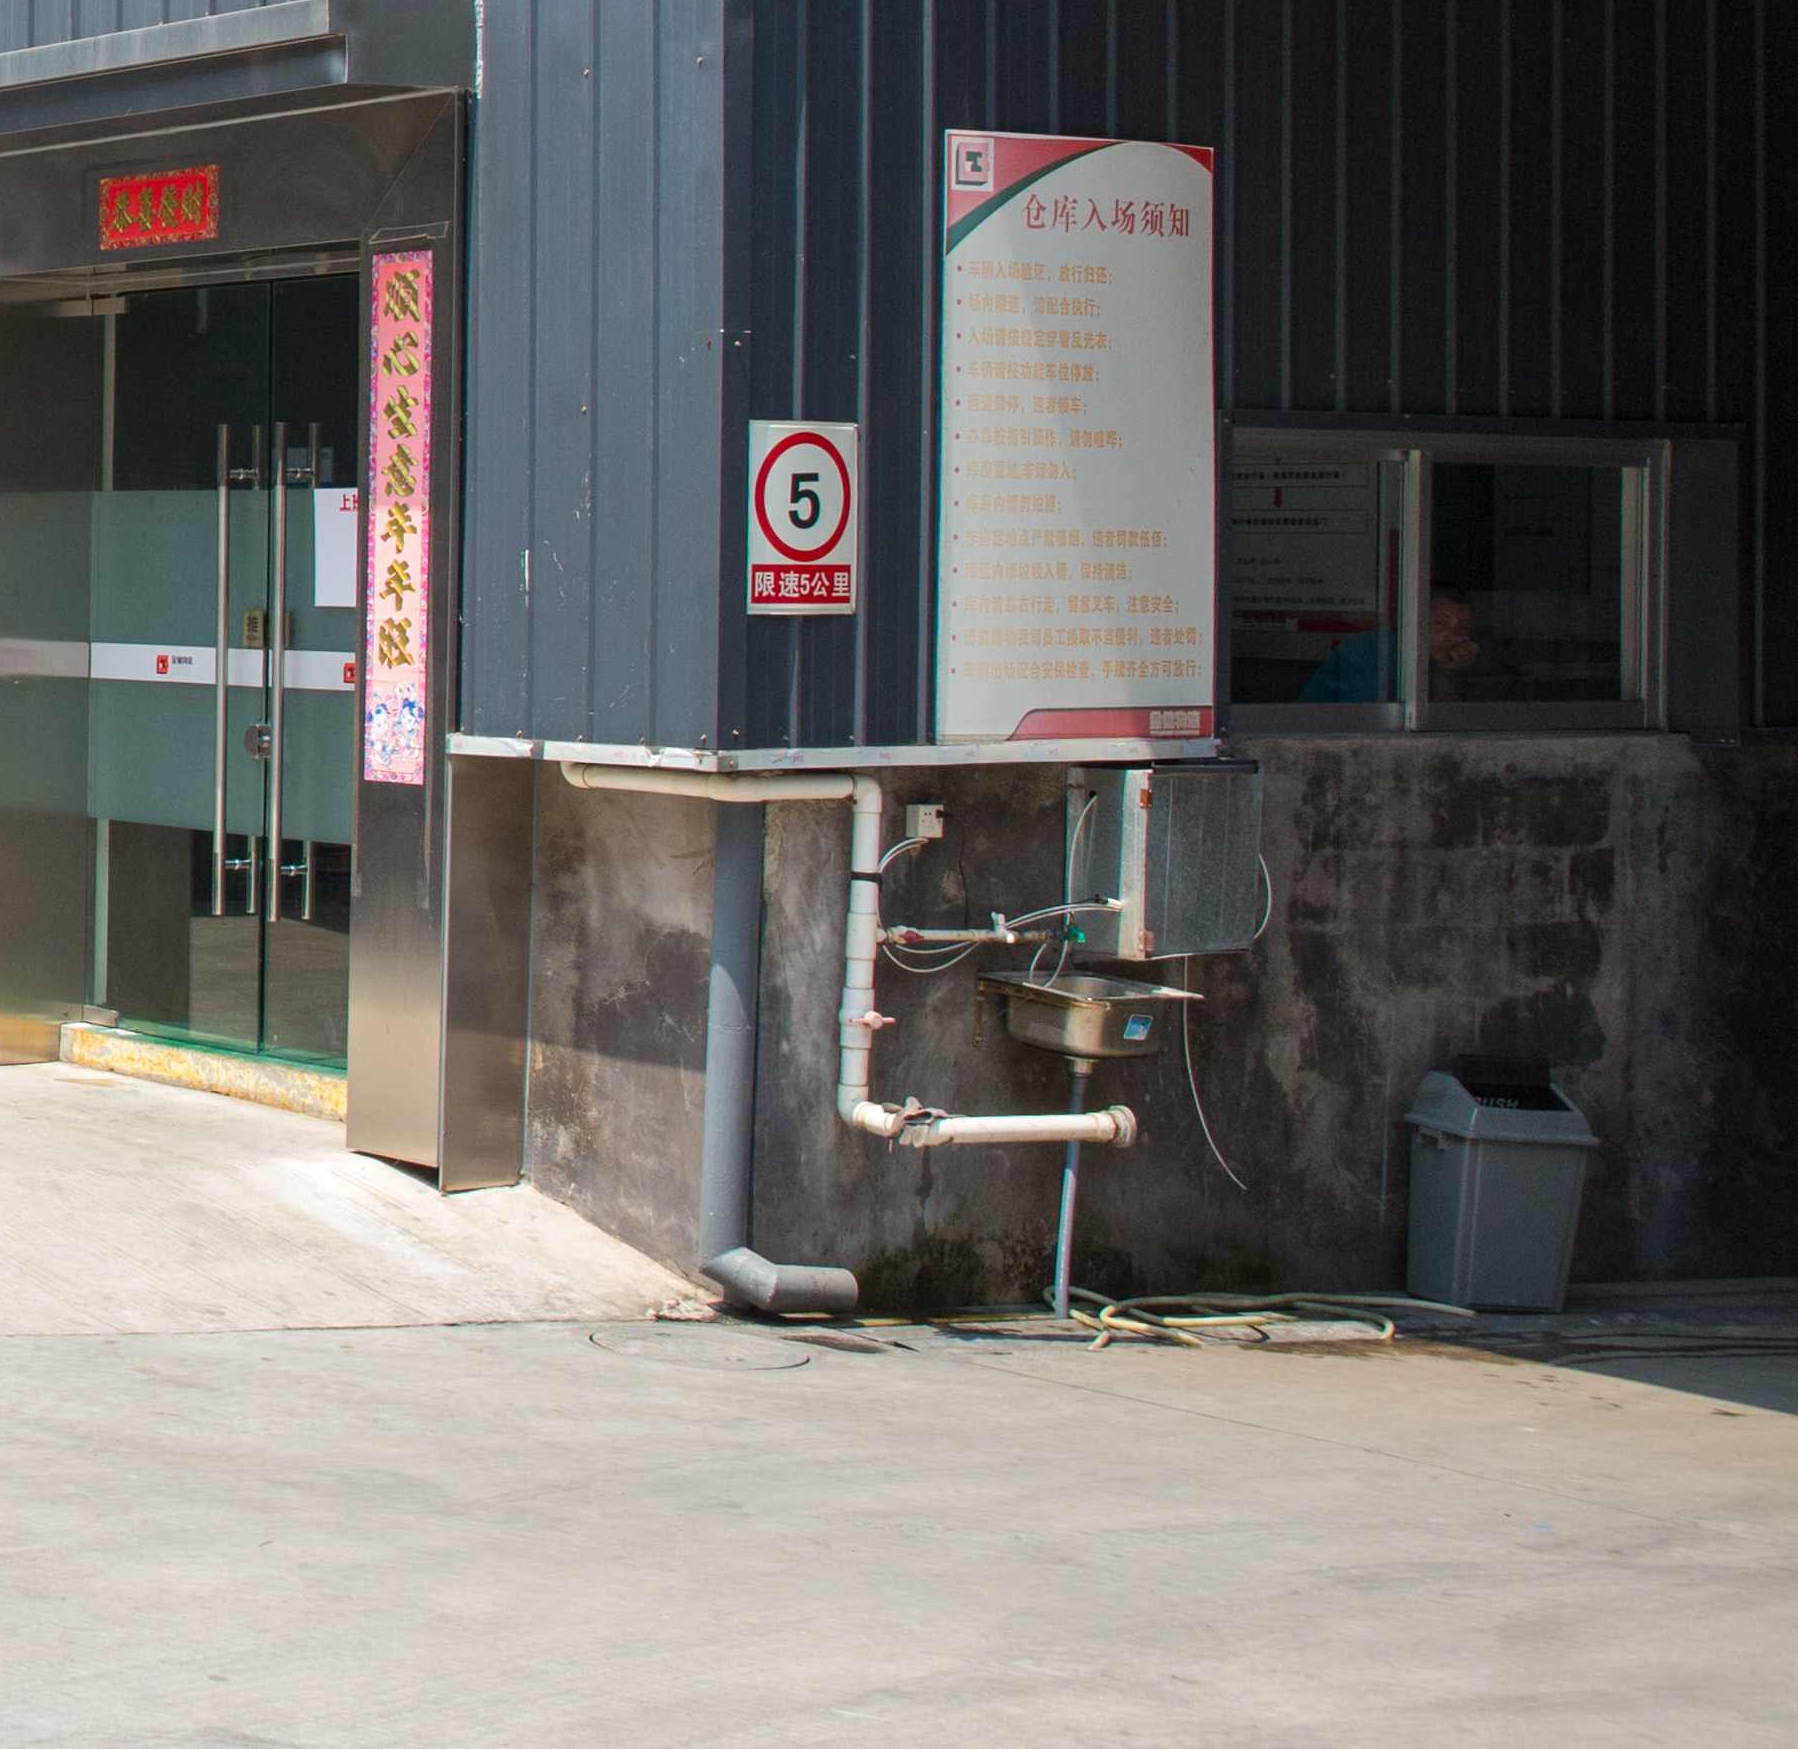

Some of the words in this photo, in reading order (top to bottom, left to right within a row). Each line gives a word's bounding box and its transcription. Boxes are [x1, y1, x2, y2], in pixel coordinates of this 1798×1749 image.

[1024, 194, 1190, 237] 仓库入场须知
[788, 472, 821, 529] 5
[755, 570, 851, 597] 限速5公里
